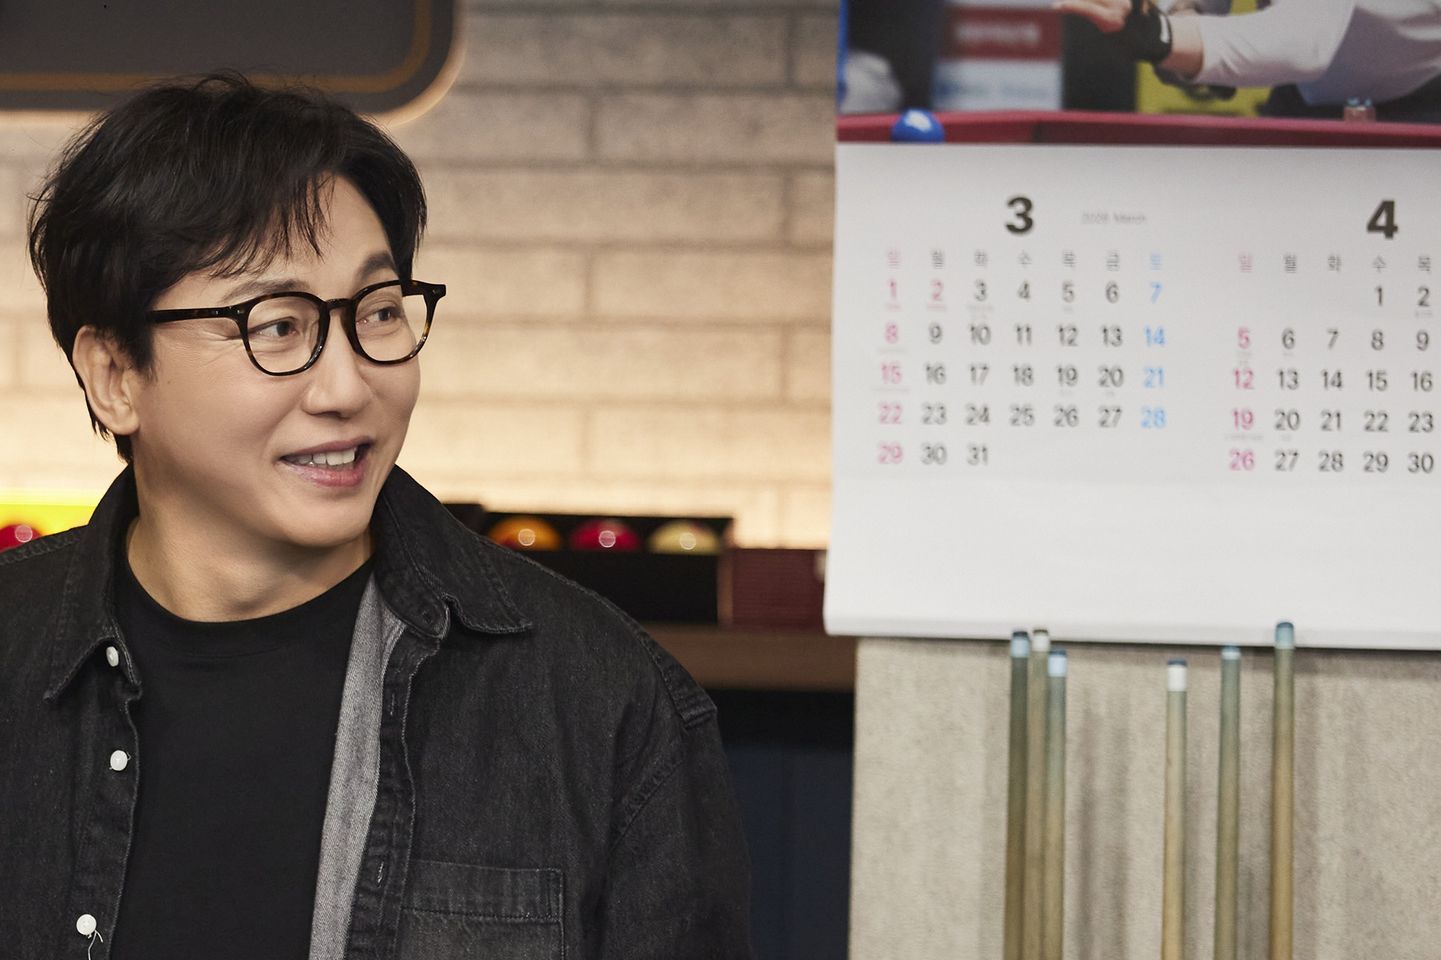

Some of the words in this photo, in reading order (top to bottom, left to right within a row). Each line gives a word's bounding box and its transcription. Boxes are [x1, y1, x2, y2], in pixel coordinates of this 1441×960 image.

[1006, 196, 1034, 234] 3
[1366, 199, 1399, 240] 4
[888, 278, 897, 300] 1
[931, 279, 944, 301] 2
[975, 280, 987, 302] 3
[1018, 281, 1031, 300] 4
[1062, 280, 1075, 303] 5
[1105, 281, 1119, 303] 6
[1150, 281, 1163, 304] 7
[1375, 286, 1383, 306] 1
[1418, 286, 1430, 307] 2
[885, 322, 899, 344] 8
[928, 322, 943, 344] 9
[970, 323, 991, 345] 10
[1016, 324, 1032, 345] 11
[1058, 325, 1078, 346] 12
[1102, 326, 1122, 347] 13
[1144, 326, 1166, 346] 14
[1237, 327, 1251, 349] 5
[1282, 328, 1295, 349] 6
[1327, 328, 1340, 350] 7
[1371, 330, 1384, 351] 8
[1416, 330, 1430, 351] 9
[881, 362, 902, 384] 15
[926, 363, 946, 384] 16
[970, 363, 990, 384] 17
[1013, 365, 1034, 386] 18
[1057, 366, 1078, 386] 19
[1098, 366, 1124, 387] 20
[1143, 367, 1164, 388] 21
[1233, 367, 1254, 389] 12
[1278, 369, 1299, 390] 13
[1323, 369, 1343, 389] 14
[1367, 370, 1388, 391] 15
[1411, 371, 1433, 392] 16
[878, 401, 903, 424] 22
[922, 402, 947, 425] 23
[966, 404, 990, 425] 24
[1010, 404, 1035, 426] 25
[1054, 406, 1079, 427] 26
[1099, 406, 1122, 428] 27
[1140, 406, 1167, 429] 28
[1232, 408, 1254, 430] 19
[1275, 409, 1300, 431] 20
[1321, 410, 1341, 431] 21
[1364, 411, 1388, 432] 22
[1408, 412, 1434, 433] 23
[878, 442, 904, 464] 29
[922, 443, 947, 465] 30
[967, 444, 988, 465] 31
[1229, 449, 1255, 471] 26
[1275, 450, 1300, 471] 27
[1319, 451, 1344, 472] 28
[1363, 452, 1389, 473] 29
[1408, 453, 1434, 473] 30
